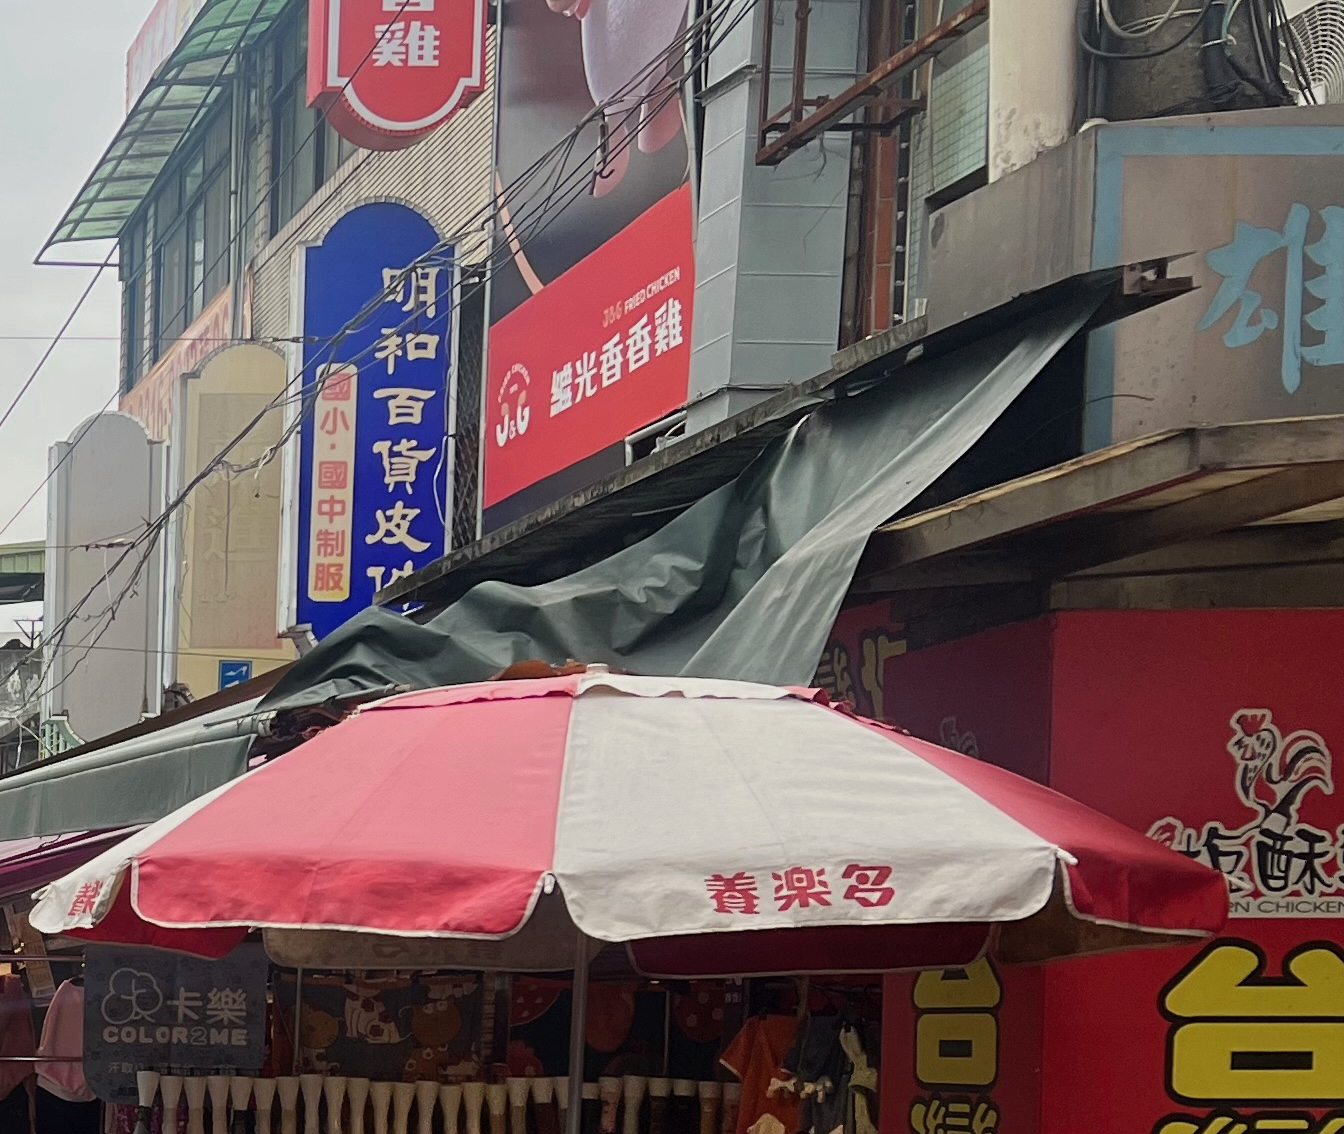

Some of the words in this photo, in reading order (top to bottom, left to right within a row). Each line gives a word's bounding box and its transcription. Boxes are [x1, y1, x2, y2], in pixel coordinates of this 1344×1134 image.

[624, 293, 646, 315] FRIED
[646, 266, 681, 298] CHICKEN
[550, 297, 683, 417] 繼光香香雞
[496, 404, 531, 447] J&G
[167, 987, 247, 1025] 卡樂
[102, 1026, 248, 1046] COLOR2ME
